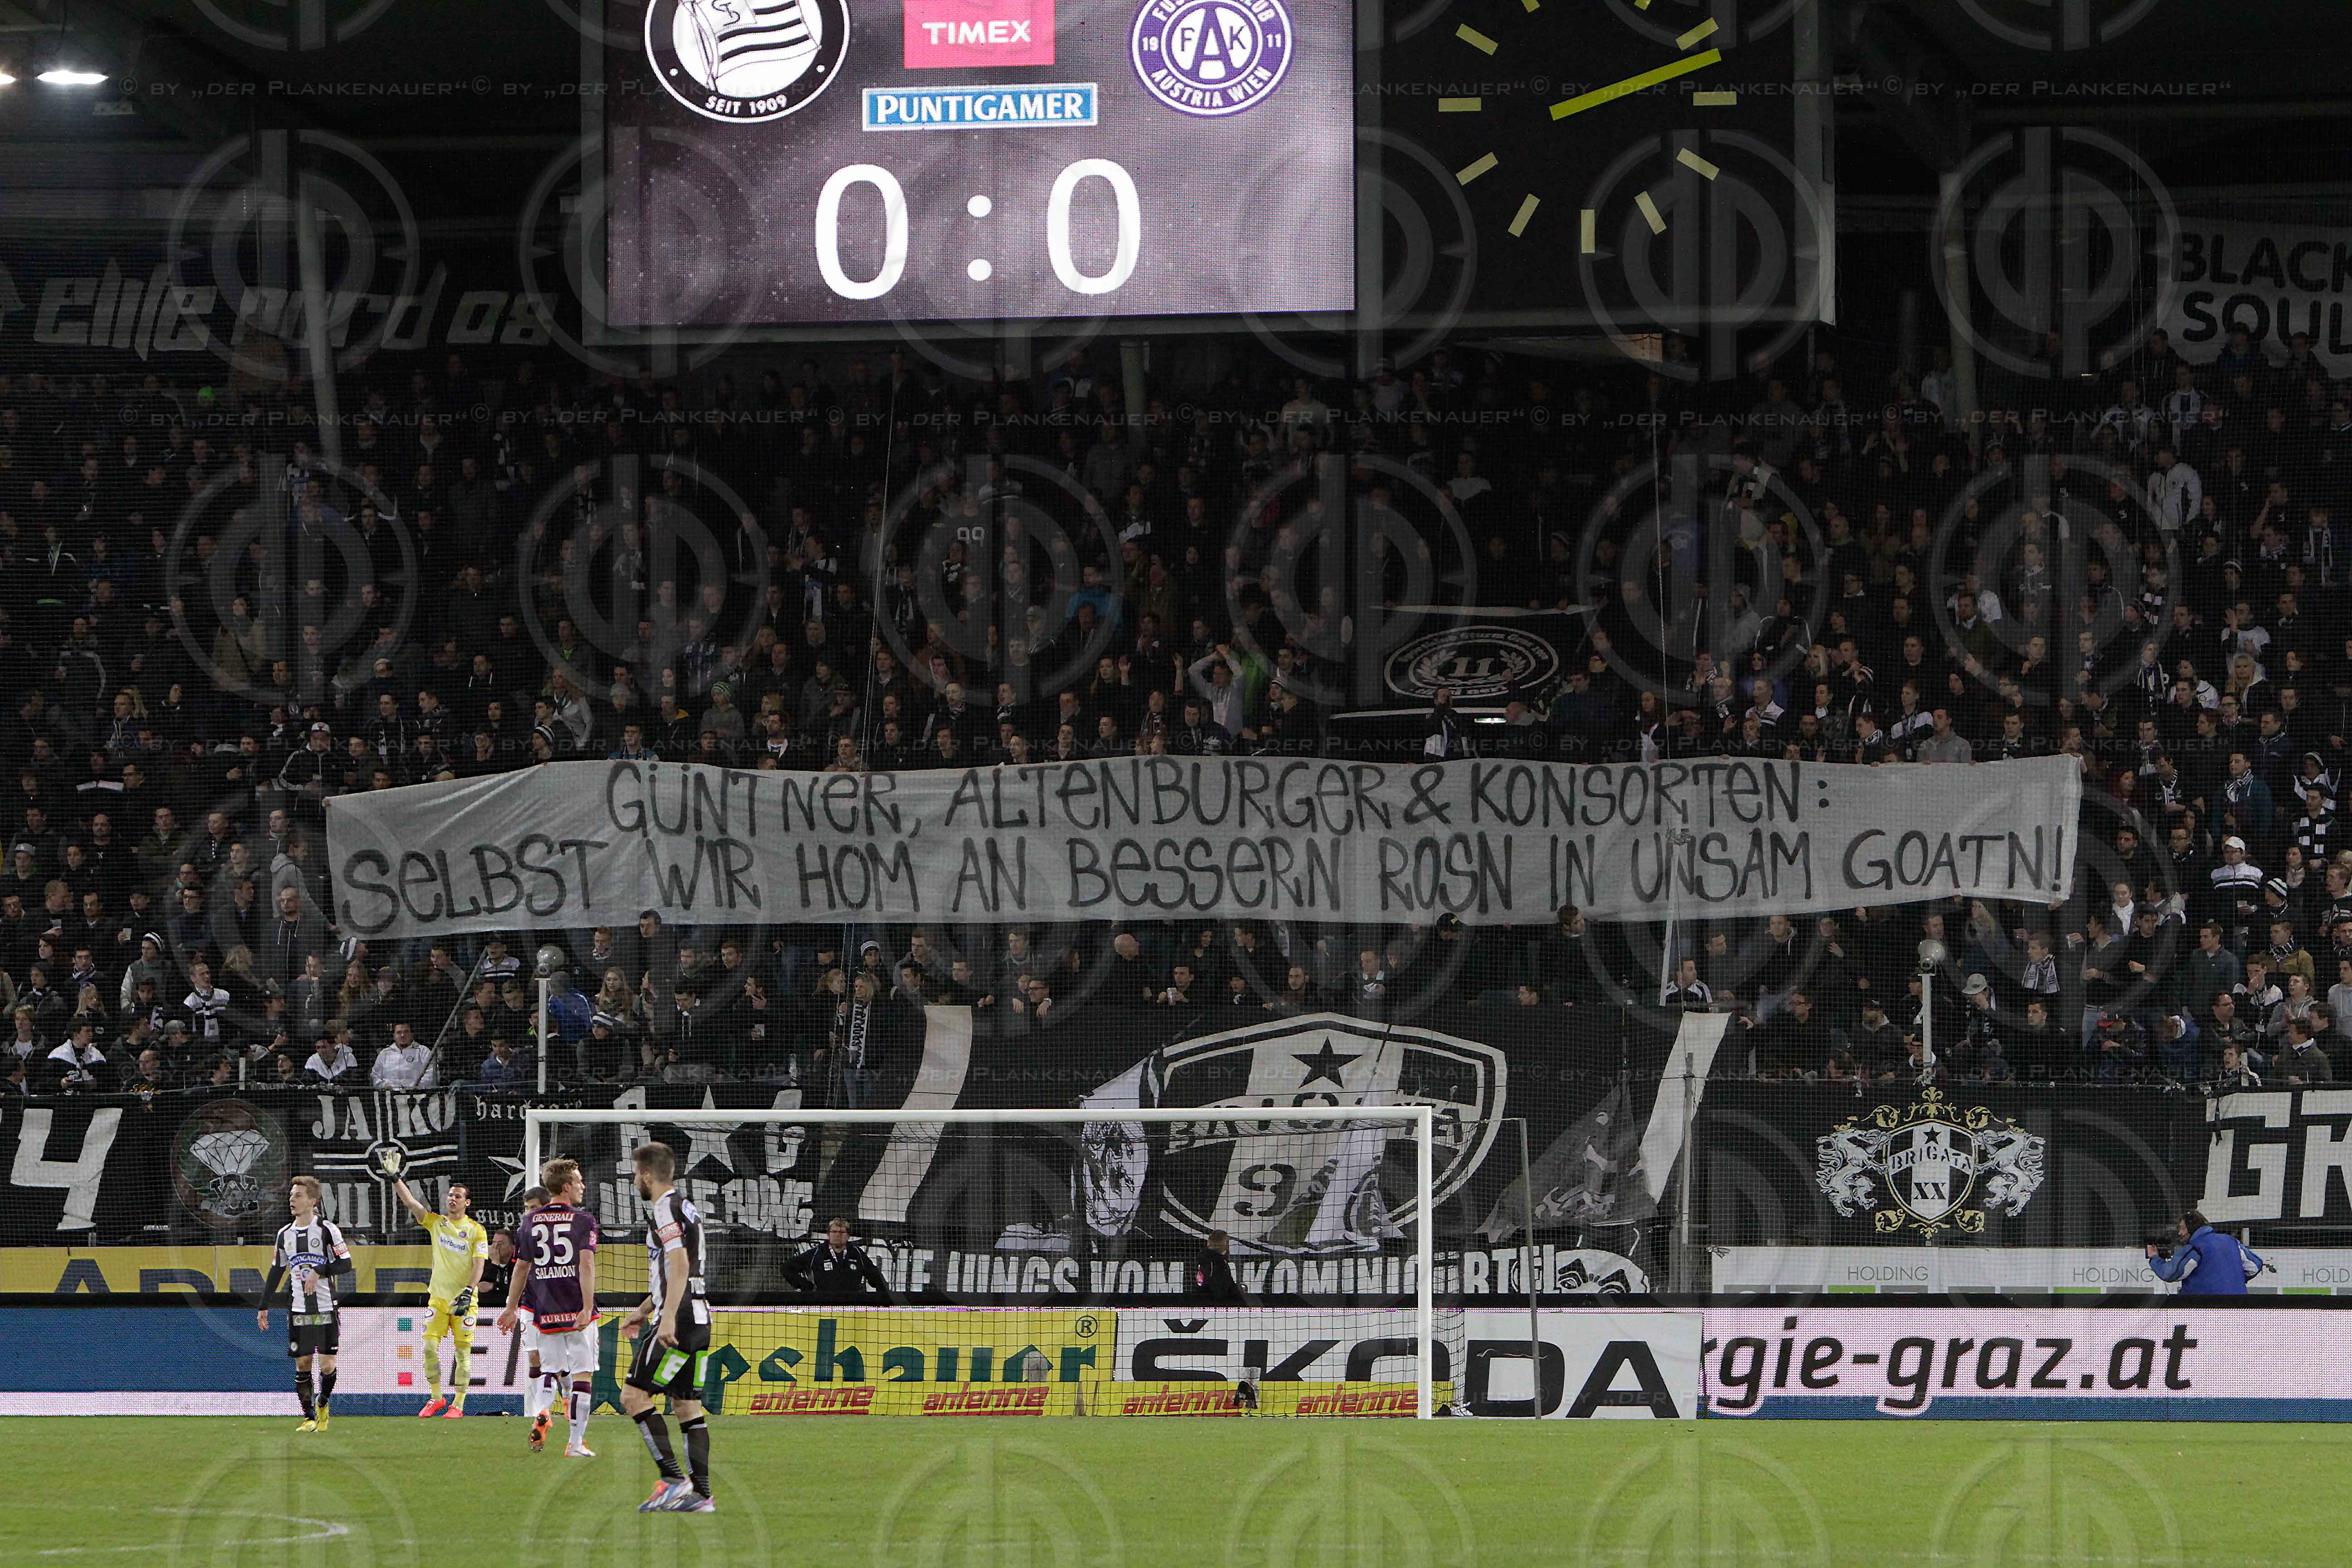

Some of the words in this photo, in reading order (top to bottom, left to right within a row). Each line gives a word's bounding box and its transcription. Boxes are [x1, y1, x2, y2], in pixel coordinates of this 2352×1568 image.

[921, 20, 1031, 44] TIMEX
[1151, 68, 1224, 107] AUSTRIA
[1228, 65, 1273, 103] WIEN
[705, 96, 741, 115] SEIT
[749, 94, 787, 115] 1909
[877, 93, 1084, 123] PUNTIGAMER
[814, 163, 909, 300] 0
[1047, 158, 1141, 295] 0
[1403, 765, 1450, 824] &
[645, 834, 762, 910] WIR
[796, 840, 921, 914] HOM
[953, 837, 1026, 913] AN
[1377, 831, 1512, 912] ROSN
[1549, 833, 1595, 912] IN
[1630, 828, 1812, 904] UNSAM
[1842, 824, 2065, 893] GOATN!
[10, 1108, 123, 1230] 4
[1891, 1145, 1971, 1170] BRIGATA
[1914, 1182, 1946, 1200] XX
[533, 1213, 574, 1223] GENERALI
[440, 1236, 466, 1250] Verbund
[532, 1224, 574, 1266] 35
[535, 1265, 575, 1279] SALAMON
[1091, 1260, 1184, 1294] VOM
[1847, 1265, 1929, 1282] HOLDING
[2073, 1268, 2155, 1283] HOLDING
[294, 1315, 331, 1325] GRAZ
[541, 1313, 578, 1323] KURIER
[1132, 1318, 1680, 1418] ŠKODA
[750, 1382, 876, 1410] antenne
[923, 1382, 1050, 1410] antenne
